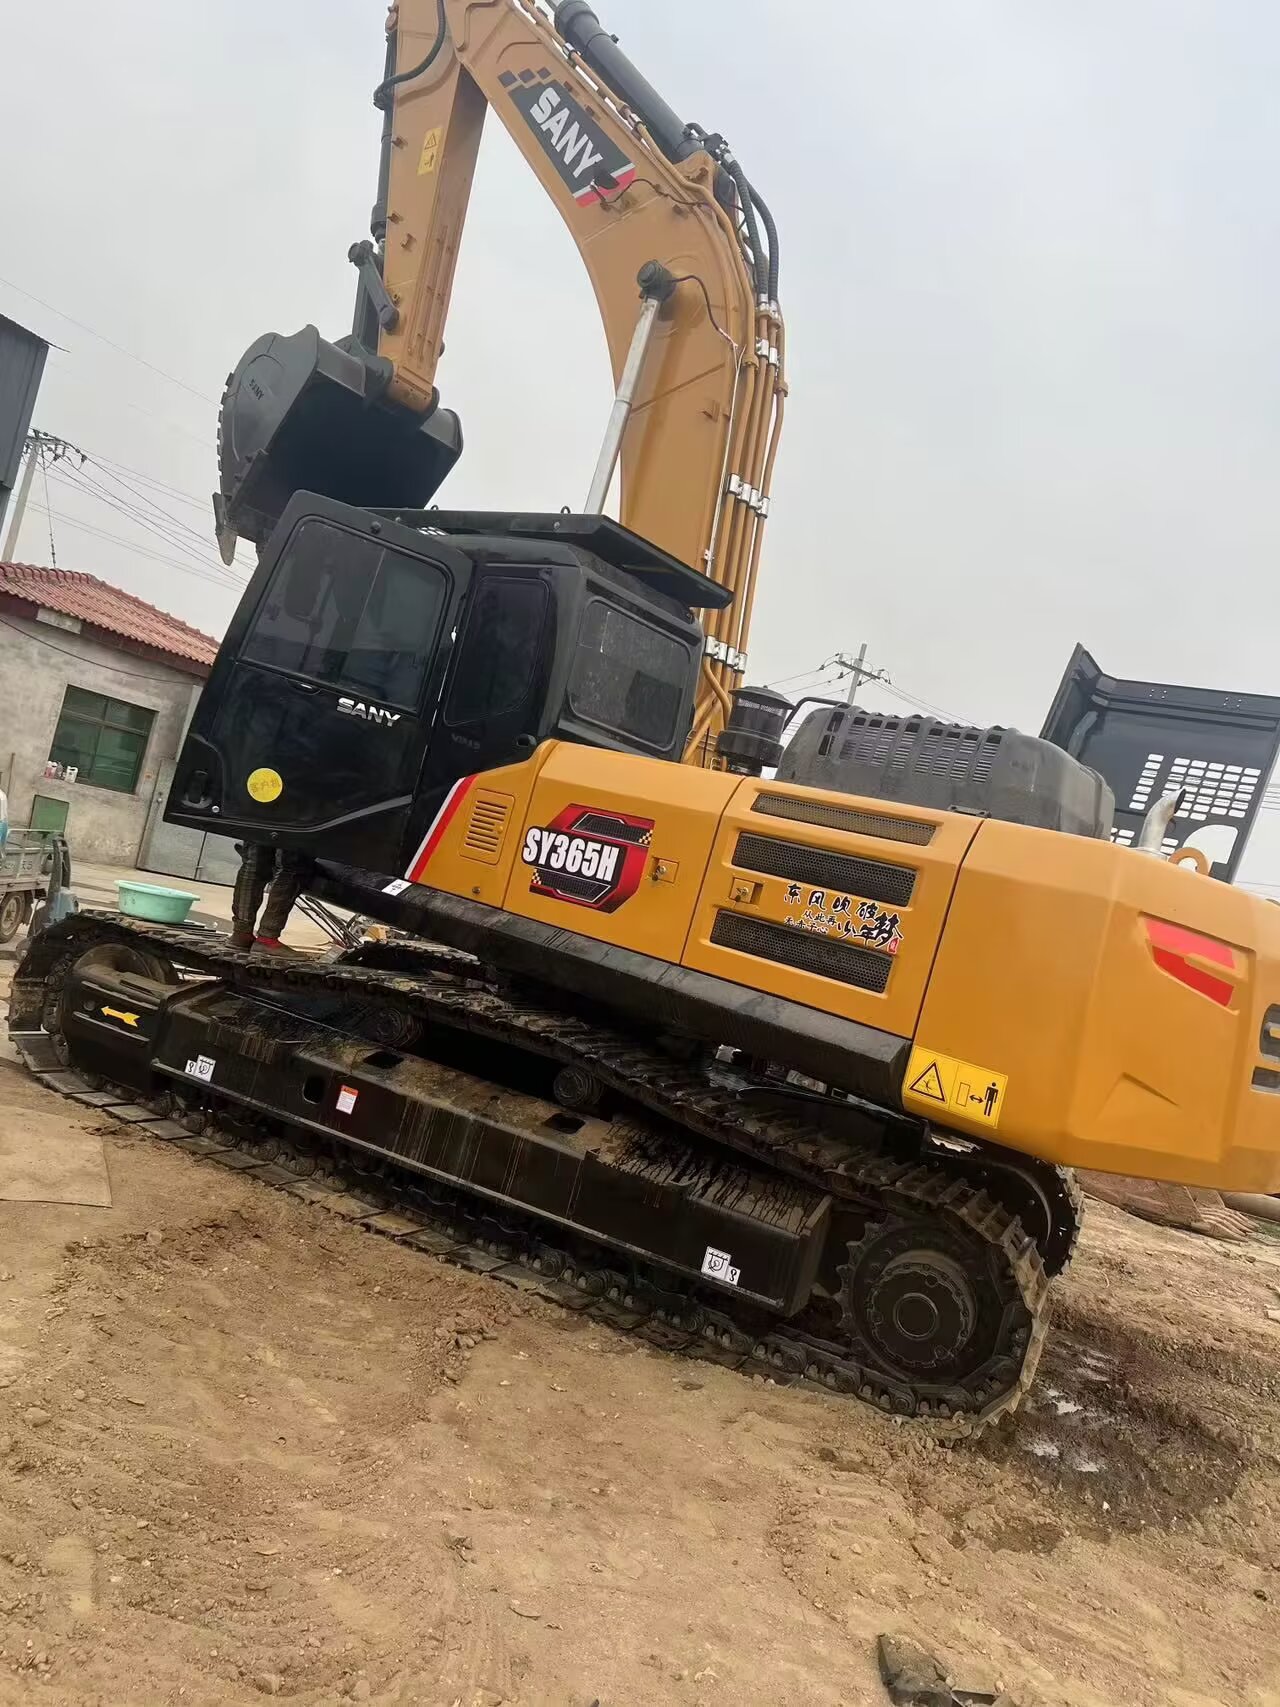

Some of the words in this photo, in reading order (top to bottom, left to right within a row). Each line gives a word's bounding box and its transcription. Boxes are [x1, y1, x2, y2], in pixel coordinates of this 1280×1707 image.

[529, 87, 604, 178] SANY
[336, 697, 402, 727] SANY
[522, 827, 620, 882] SY365H
